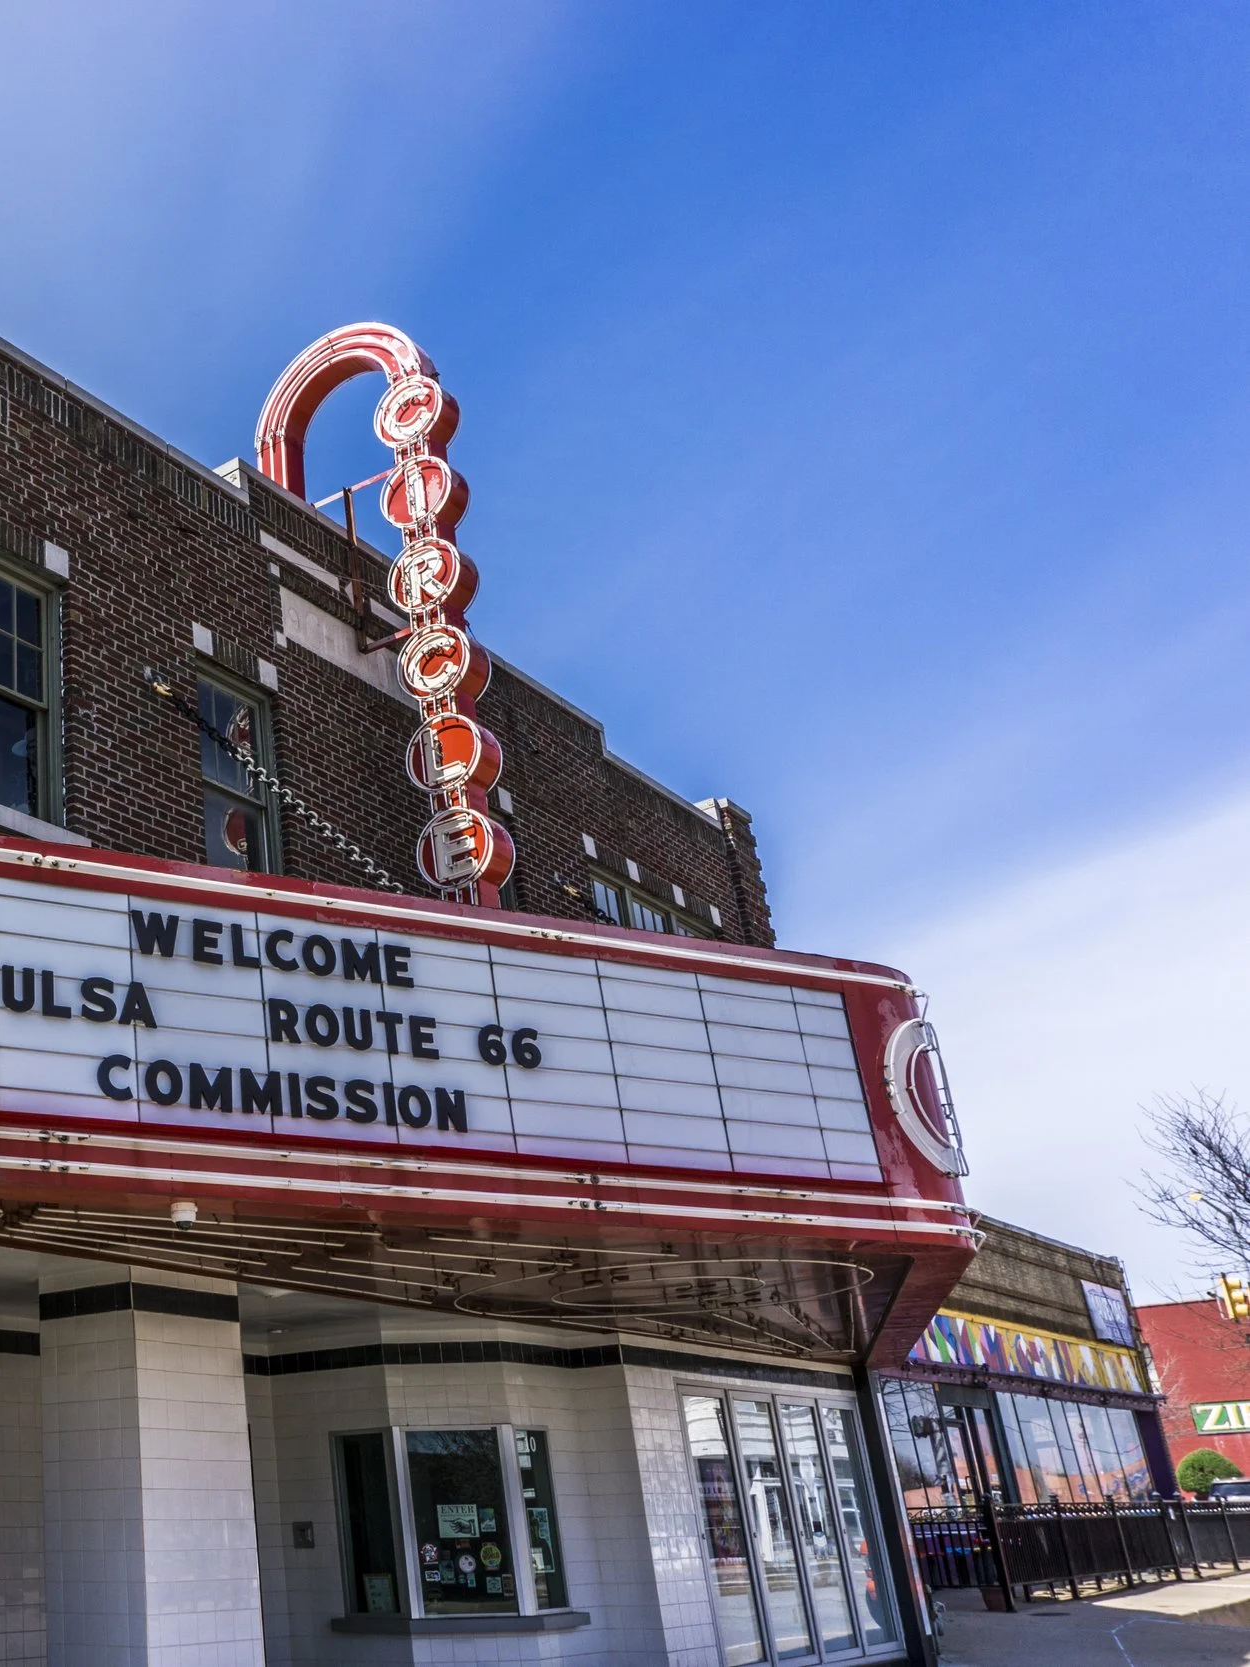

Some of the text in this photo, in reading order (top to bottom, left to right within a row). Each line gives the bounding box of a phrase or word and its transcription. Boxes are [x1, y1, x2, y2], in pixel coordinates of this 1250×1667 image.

[381, 379, 478, 882] CIRCLE
[131, 909, 415, 989] WELCOME
[268, 997, 440, 1060] ROUTE
[478, 1024, 542, 1069] 66
[97, 1054, 468, 1133] COMMISSION
[440, 1506, 475, 1514] ENTER
